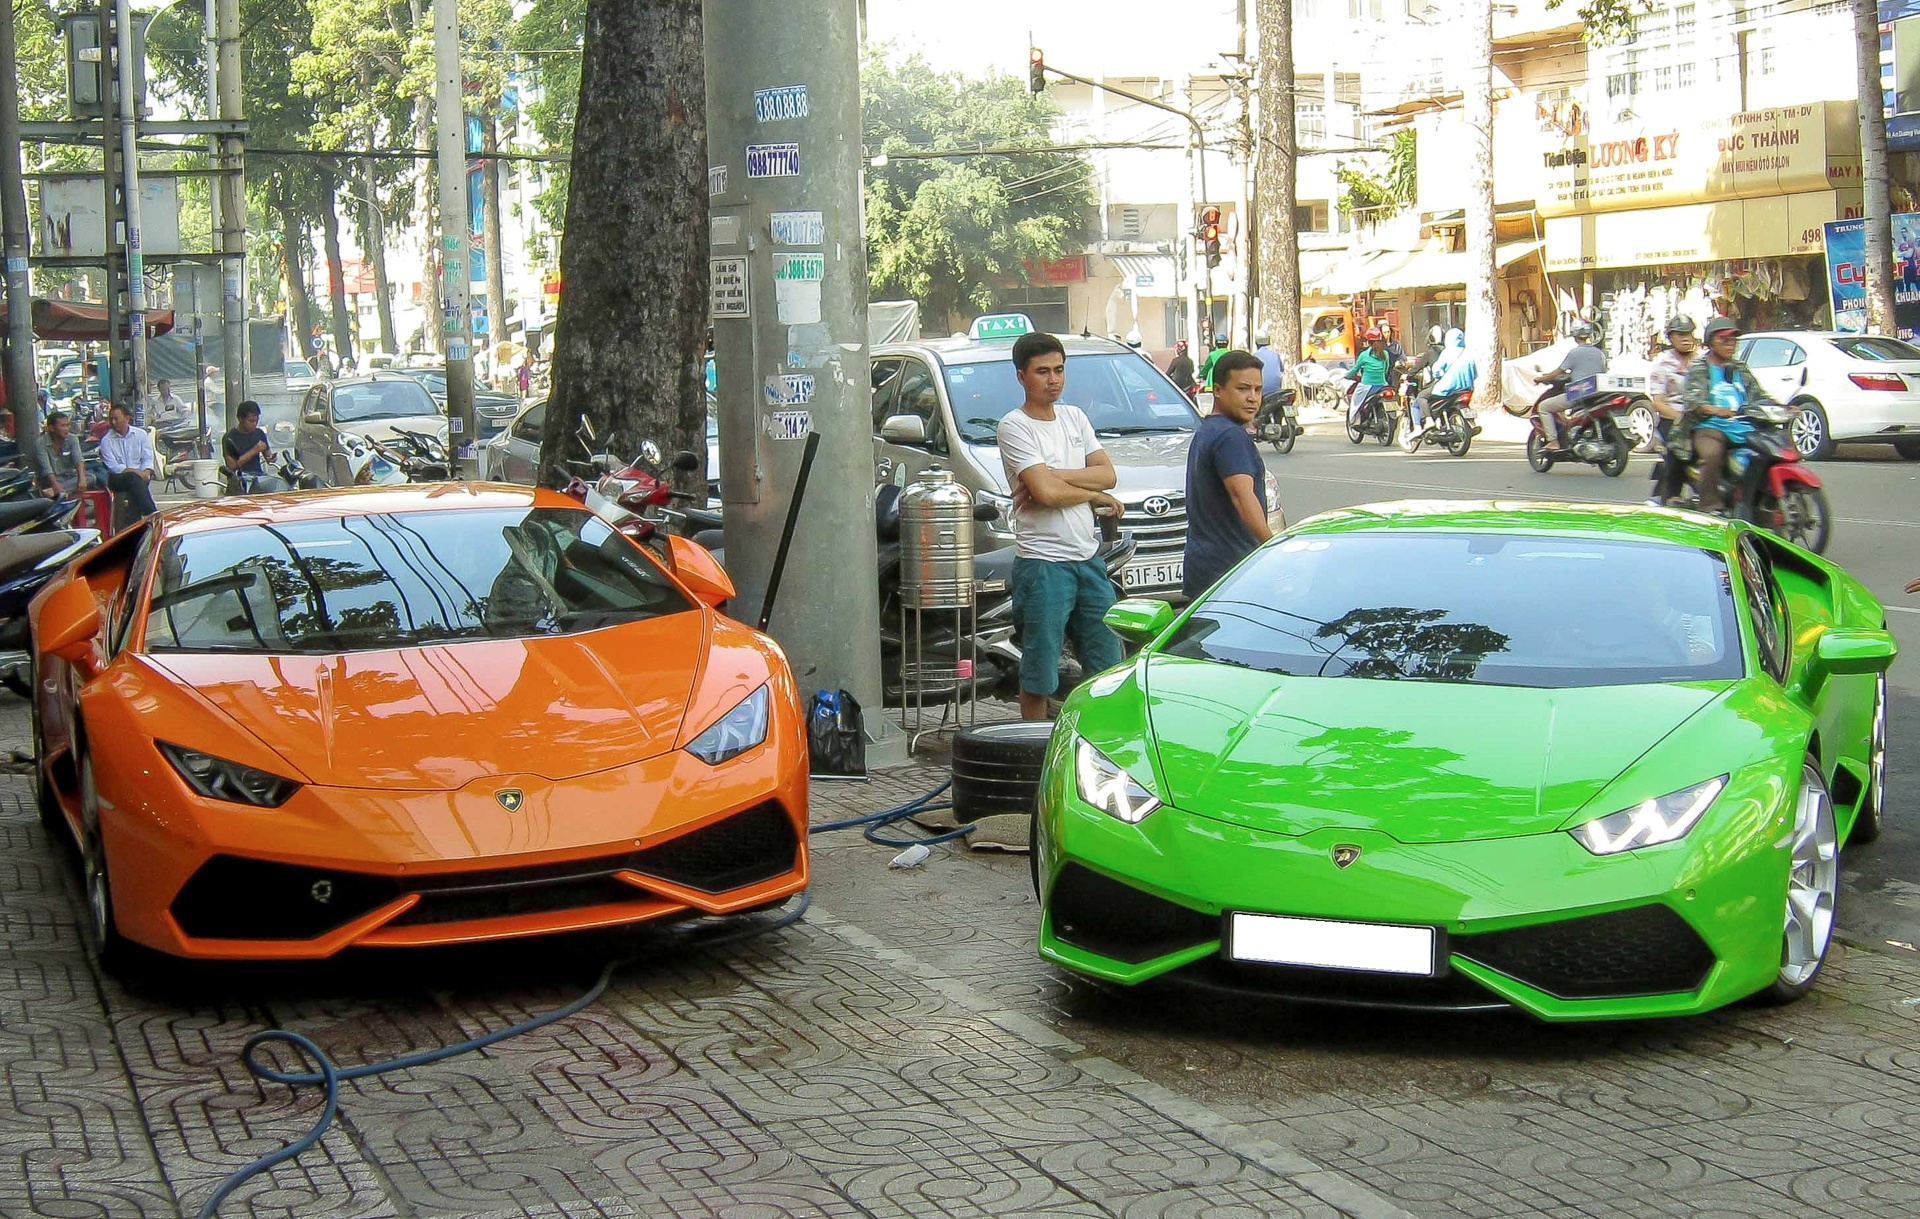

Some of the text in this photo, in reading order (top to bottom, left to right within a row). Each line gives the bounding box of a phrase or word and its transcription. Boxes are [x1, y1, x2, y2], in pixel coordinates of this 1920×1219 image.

[1738, 112, 1762, 125] TNHH
[1764, 110, 1776, 121] SX
[1751, 126, 1800, 148] THÀNH
[1771, 156, 1790, 169] SALON
[1829, 166, 1851, 178] MAY
[1801, 228, 1821, 244] 498
[979, 316, 1025, 331] TAXI
